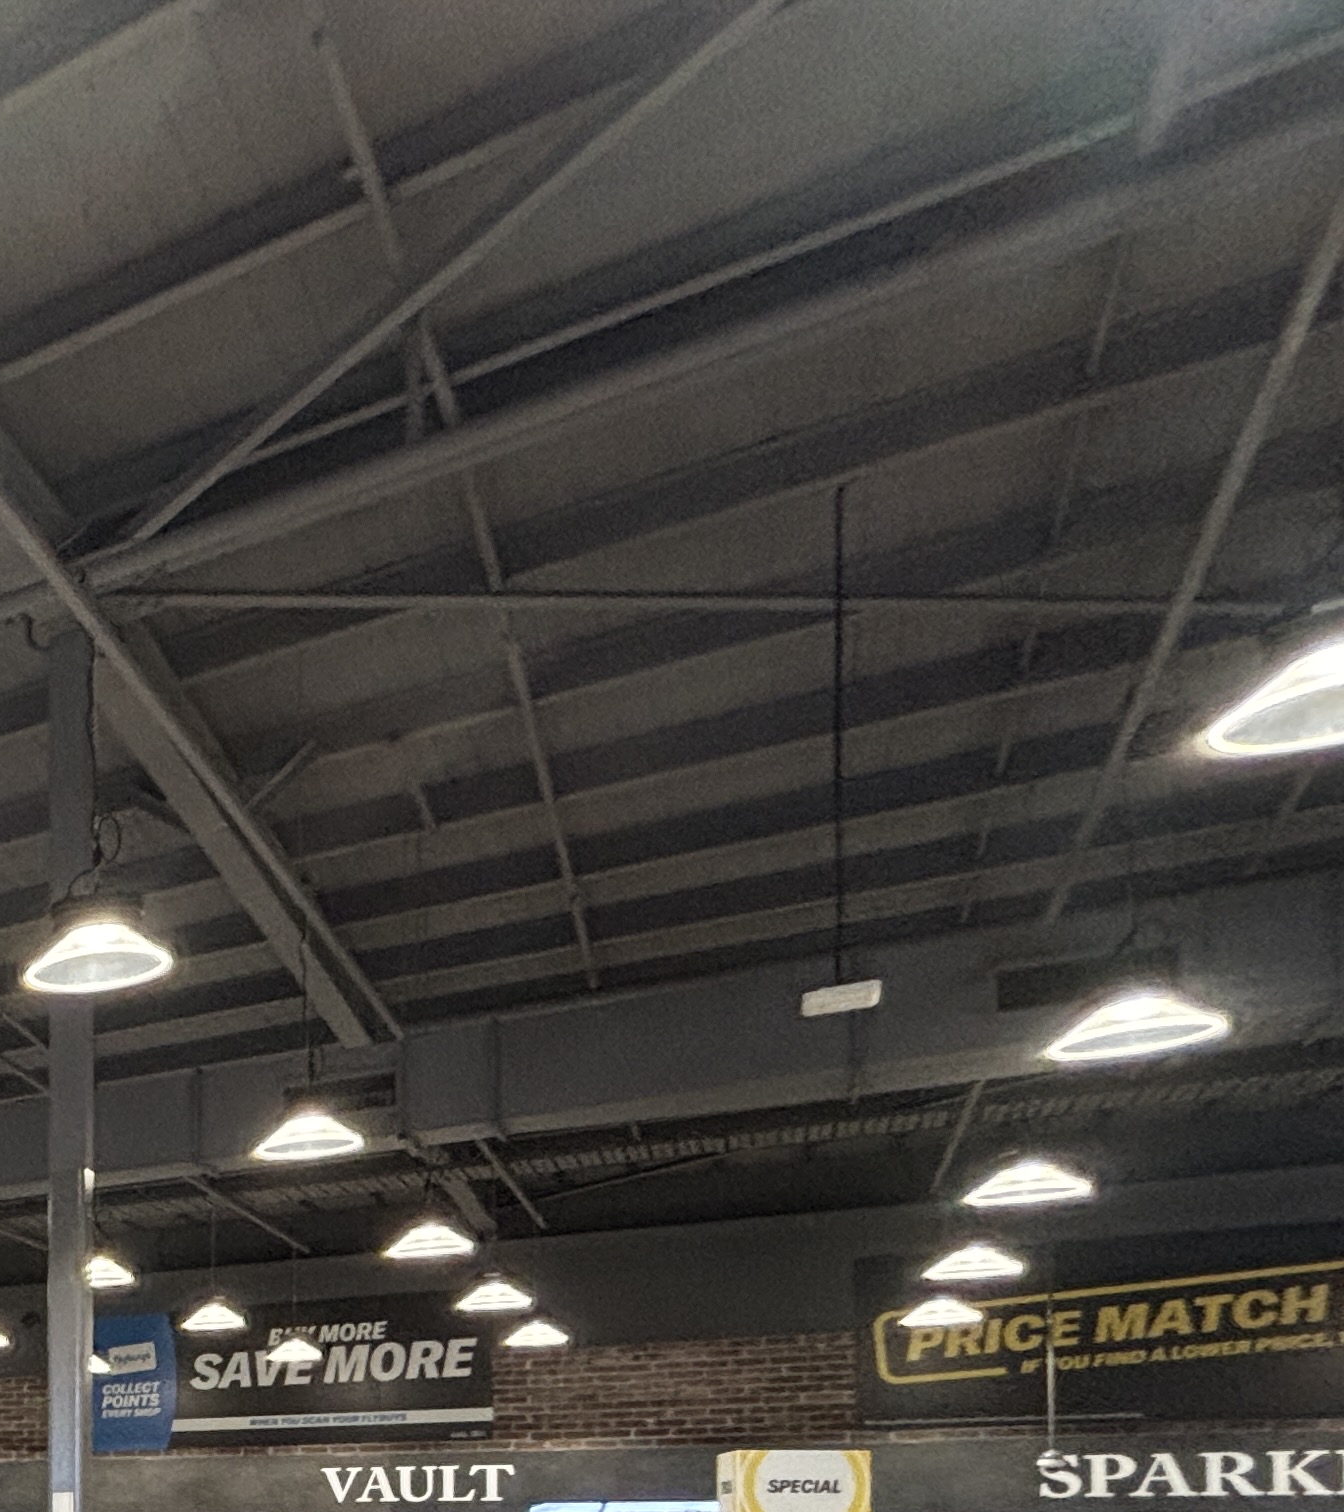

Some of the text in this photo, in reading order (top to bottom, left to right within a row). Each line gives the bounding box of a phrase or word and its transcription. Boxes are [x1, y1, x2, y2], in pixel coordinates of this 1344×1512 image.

[319, 1321, 388, 1343] MORE
[907, 1284, 1330, 1362] PRICE MATCH
[189, 1337, 478, 1391] SAVE MORE
[1021, 1359, 1041, 1375] IF
[102, 1381, 160, 1395] COLLECT
[102, 1394, 160, 1409] POINTS
[321, 1464, 515, 1504] VAULT
[767, 1479, 842, 1494] SPECIAL
